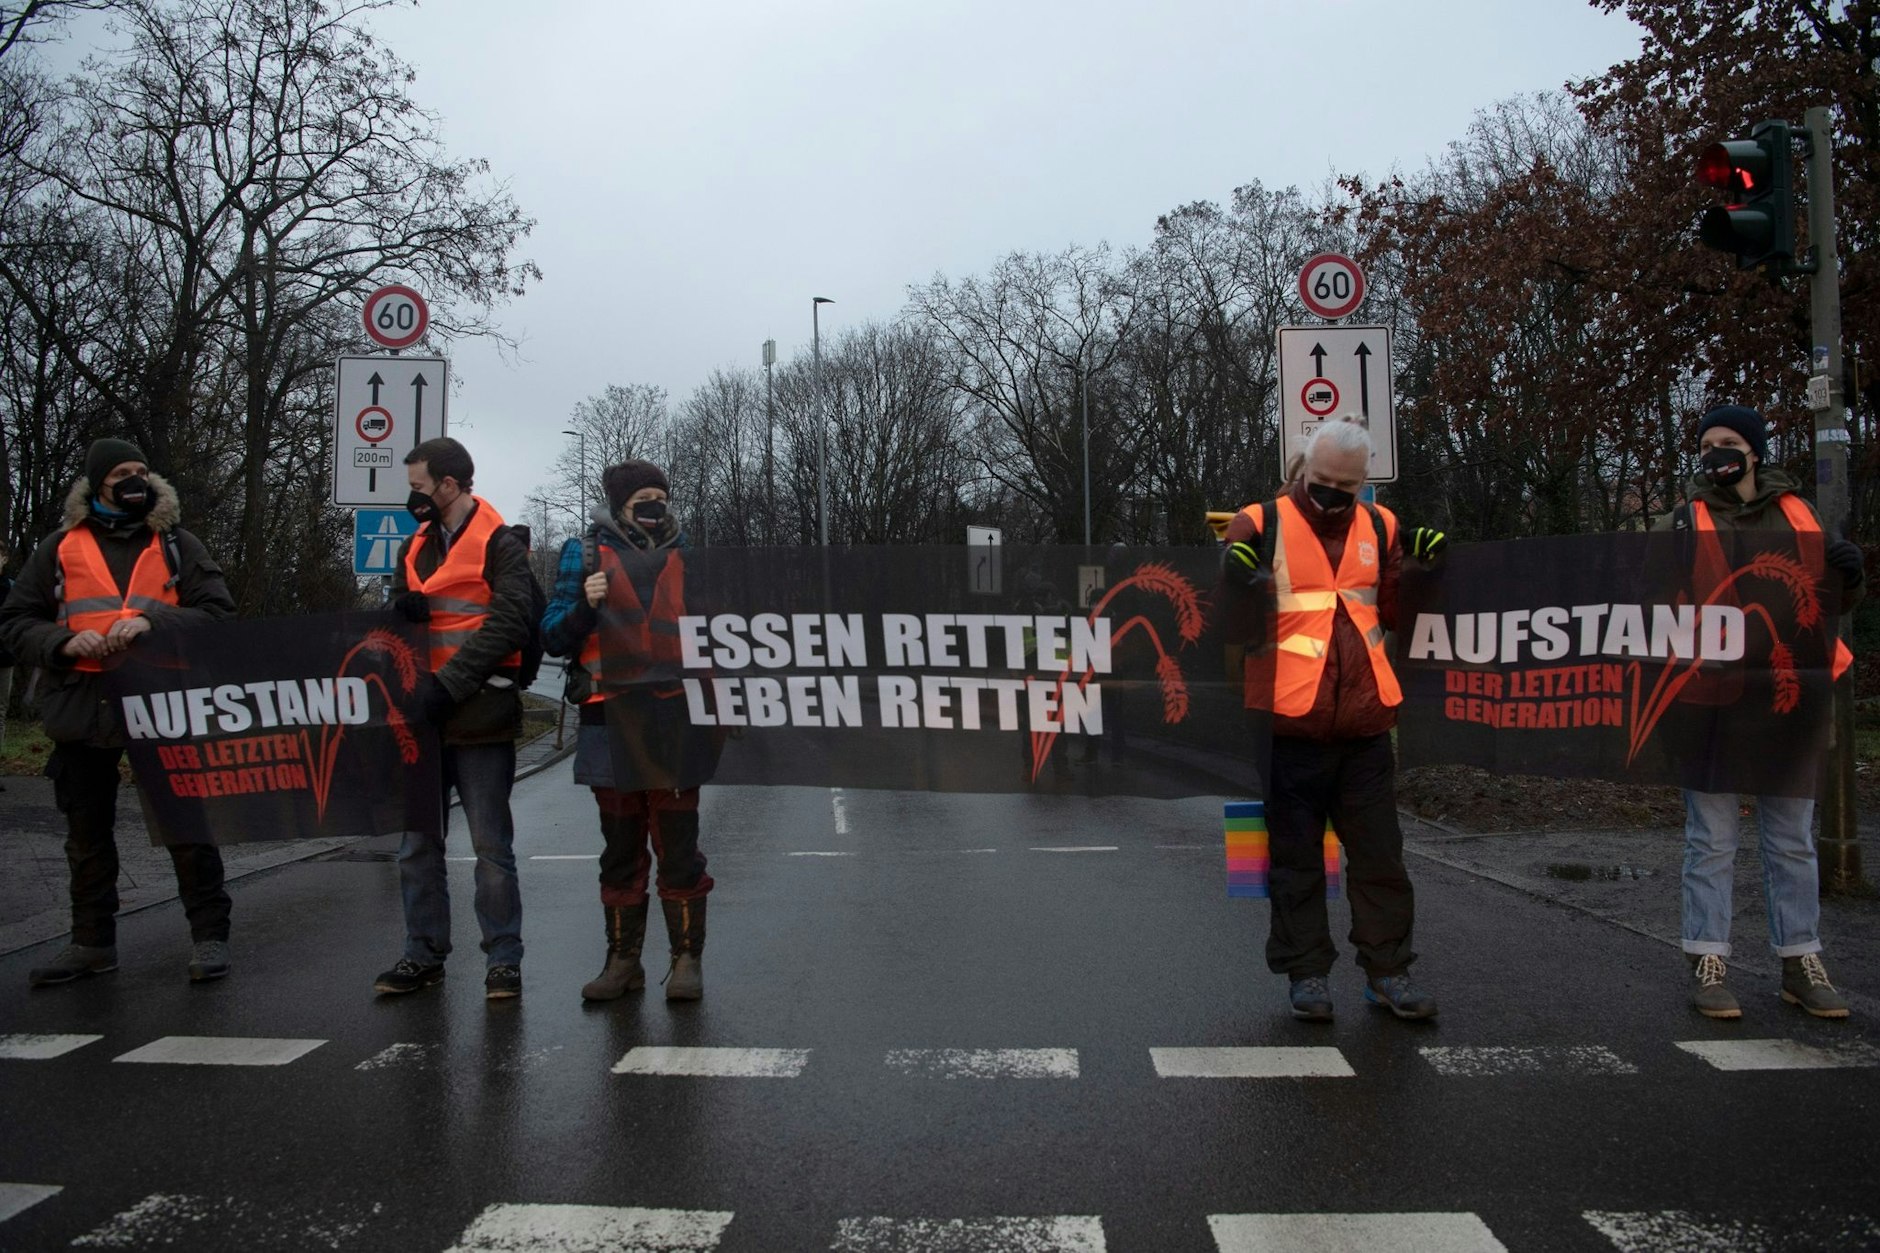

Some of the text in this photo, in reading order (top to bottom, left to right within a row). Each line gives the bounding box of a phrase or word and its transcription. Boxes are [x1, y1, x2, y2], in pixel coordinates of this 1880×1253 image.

[1314, 271, 1350, 300] 60
[377, 302, 414, 330] 60
[357, 452, 390, 464] 200m
[678, 613, 1112, 674] ESSEN RETTEN
[1408, 603, 1745, 664] AUFSTAND
[1445, 664, 1623, 699] DER LETZTEN
[122, 676, 370, 740] AUFSTAND
[682, 675, 1104, 736] LEBEN RETTEN
[1445, 697, 1623, 728] GENERATION
[157, 733, 301, 770] DER LETZTEN
